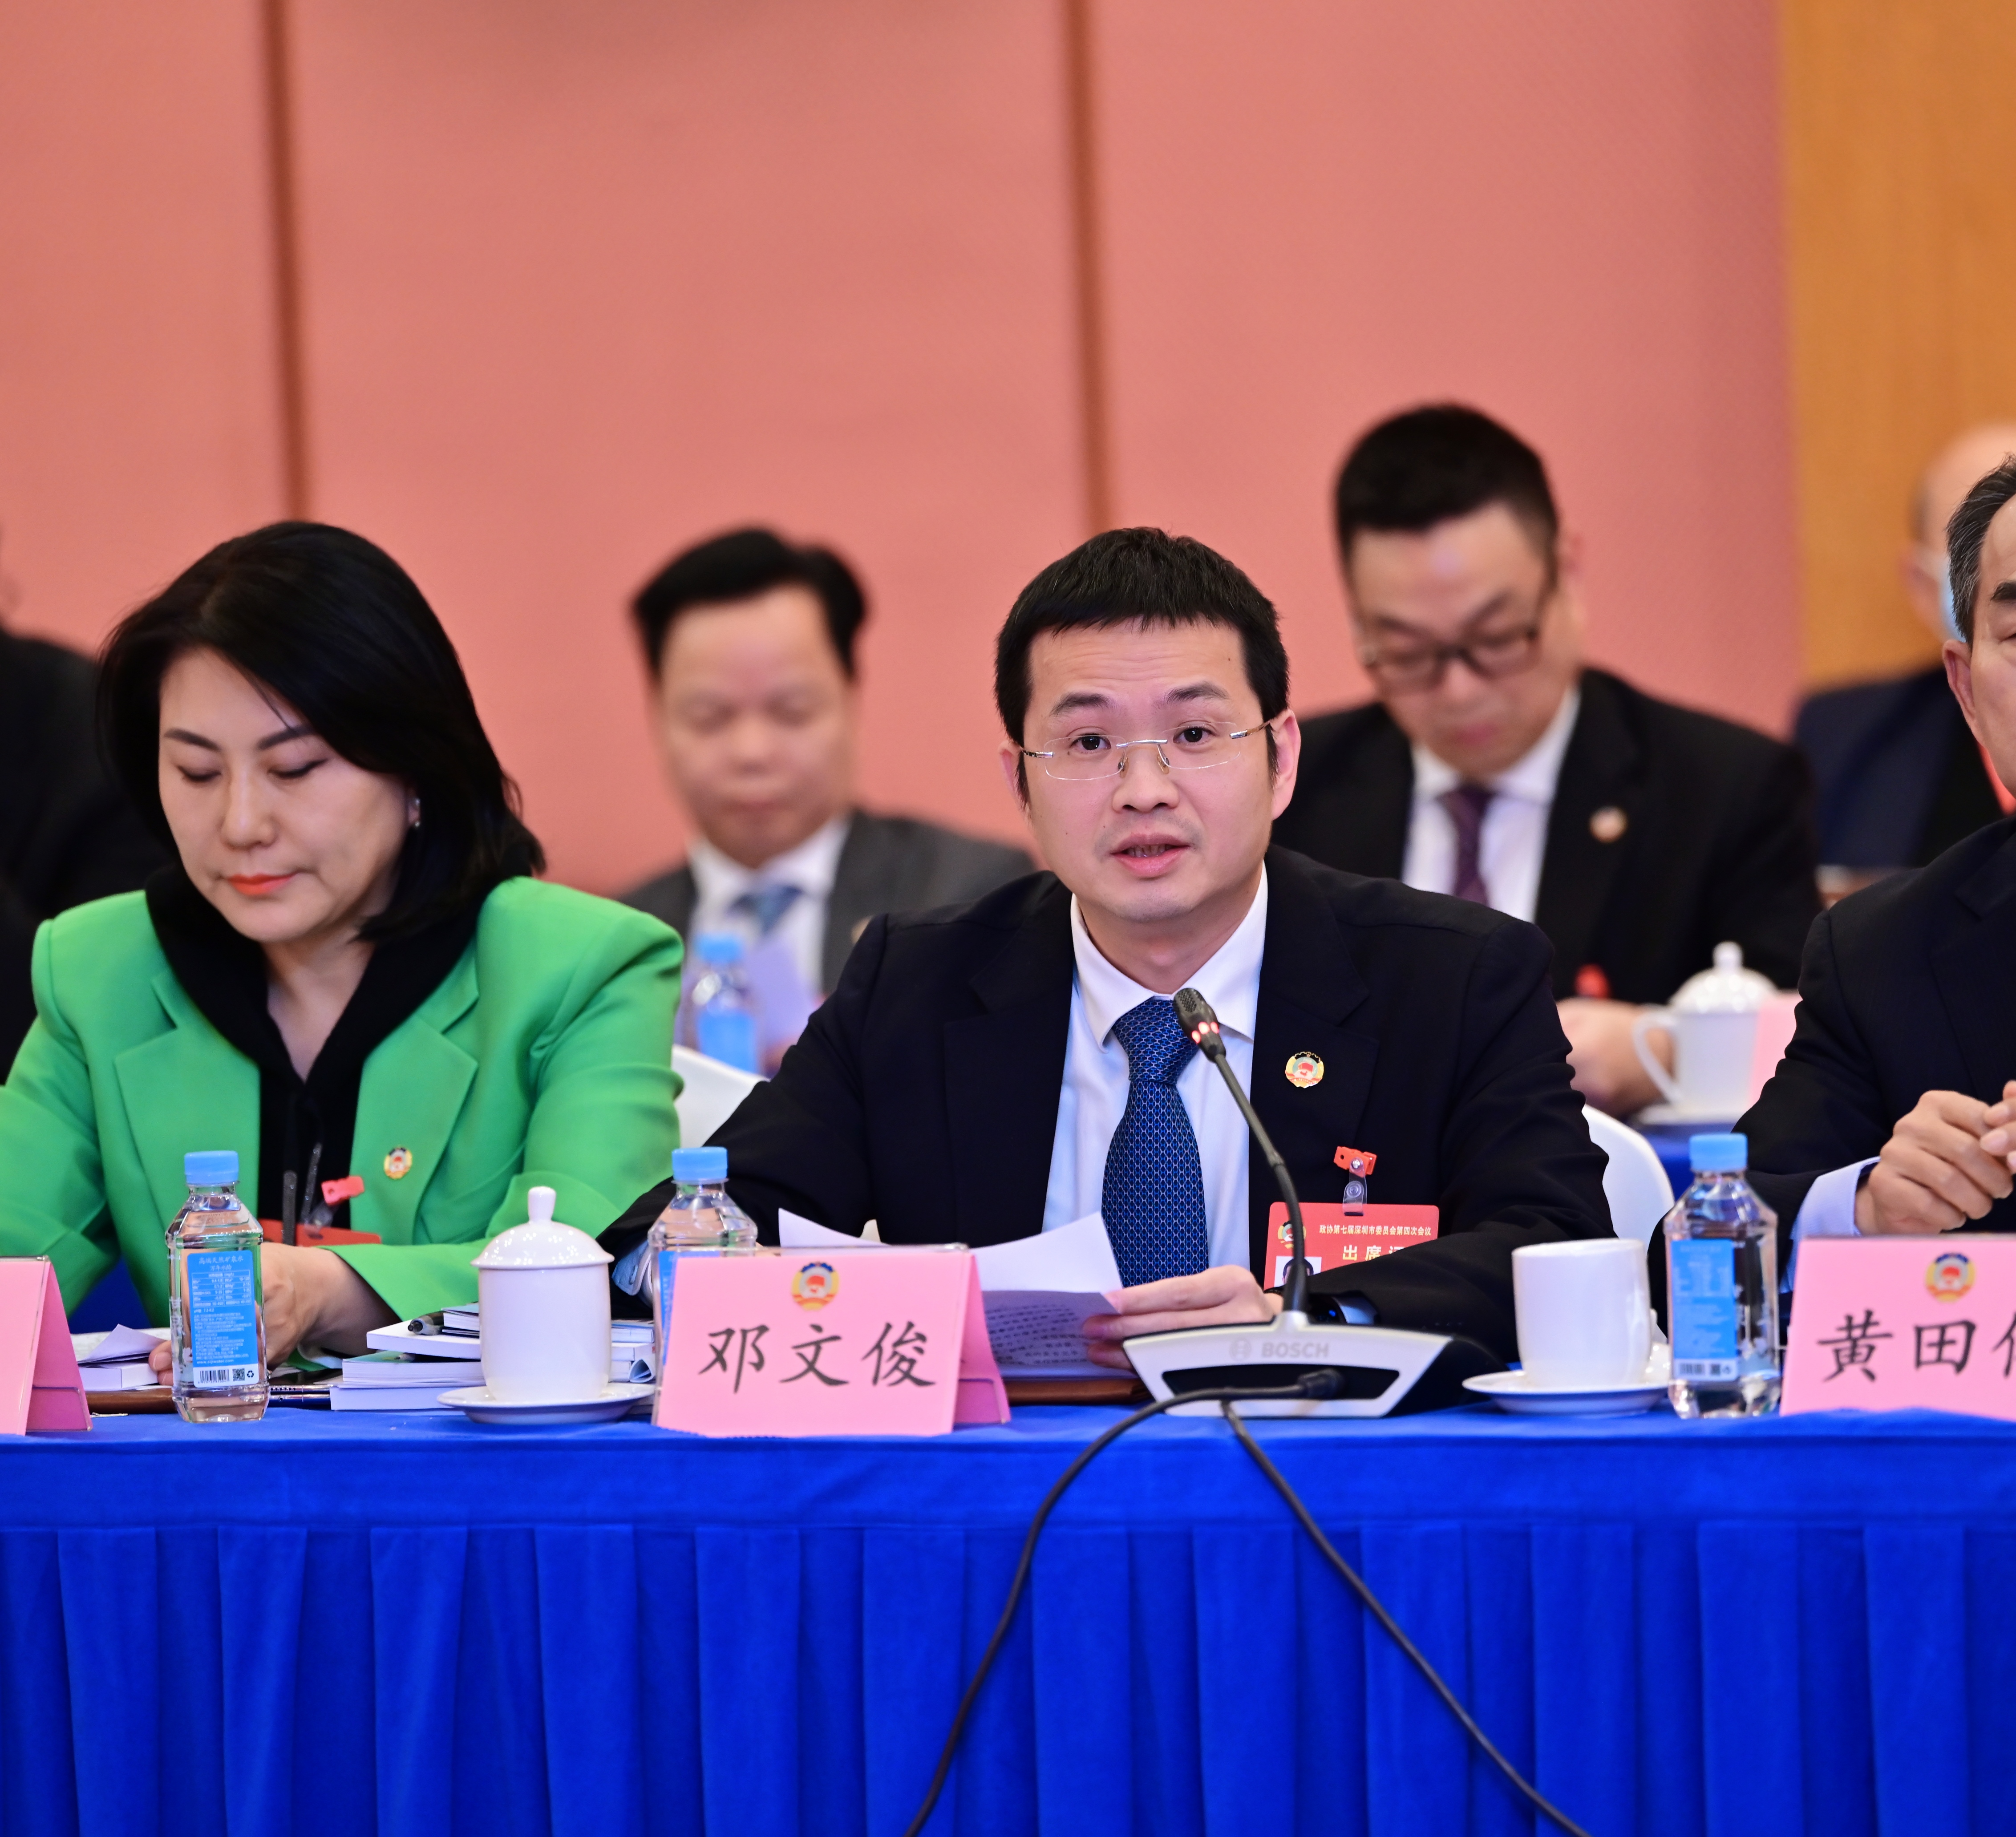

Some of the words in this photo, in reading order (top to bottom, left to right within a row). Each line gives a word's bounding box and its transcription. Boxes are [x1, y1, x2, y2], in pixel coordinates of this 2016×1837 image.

[1319, 1225, 1431, 1236] 政协第七届深圳市委员会第四次会议
[698, 1321, 936, 1394] 邓文俊
[1261, 1343, 1329, 1358] BOSCH
